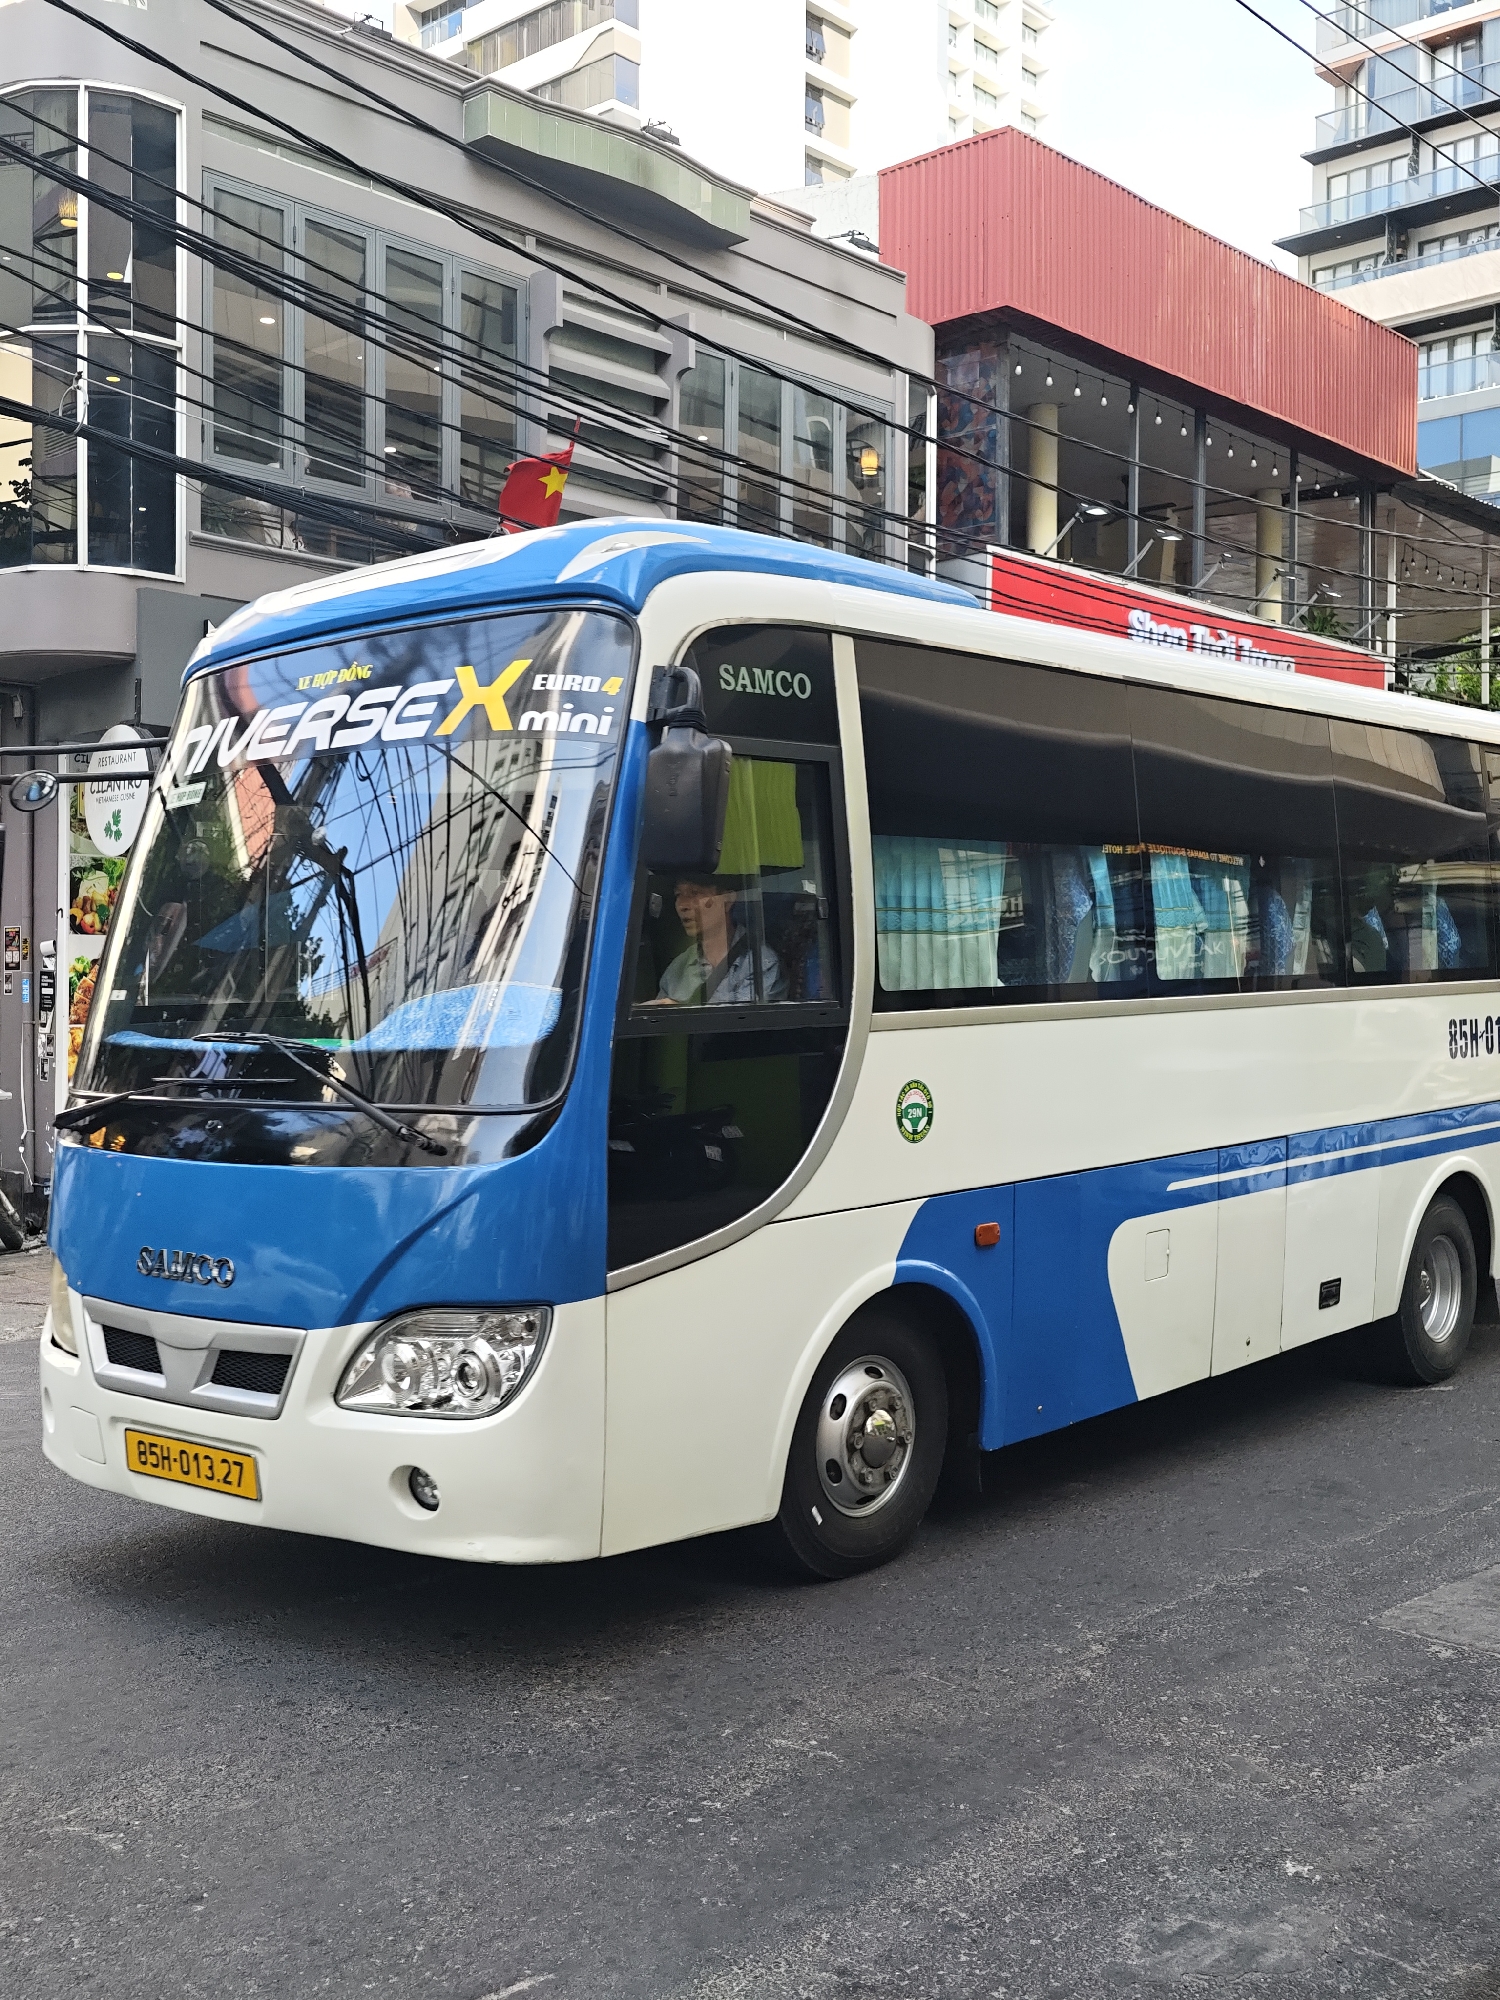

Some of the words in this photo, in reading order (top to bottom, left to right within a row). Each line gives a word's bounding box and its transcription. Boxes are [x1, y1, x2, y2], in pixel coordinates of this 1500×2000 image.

[719, 664, 812, 699] SAMCO
[518, 703, 615, 736] mini
[98, 752, 137, 768] RESTAURANT
[907, 1107, 922, 1118] 29N
[136, 1245, 236, 1288] SAMCO
[136, 1439, 244, 1488] 85H-013.27
